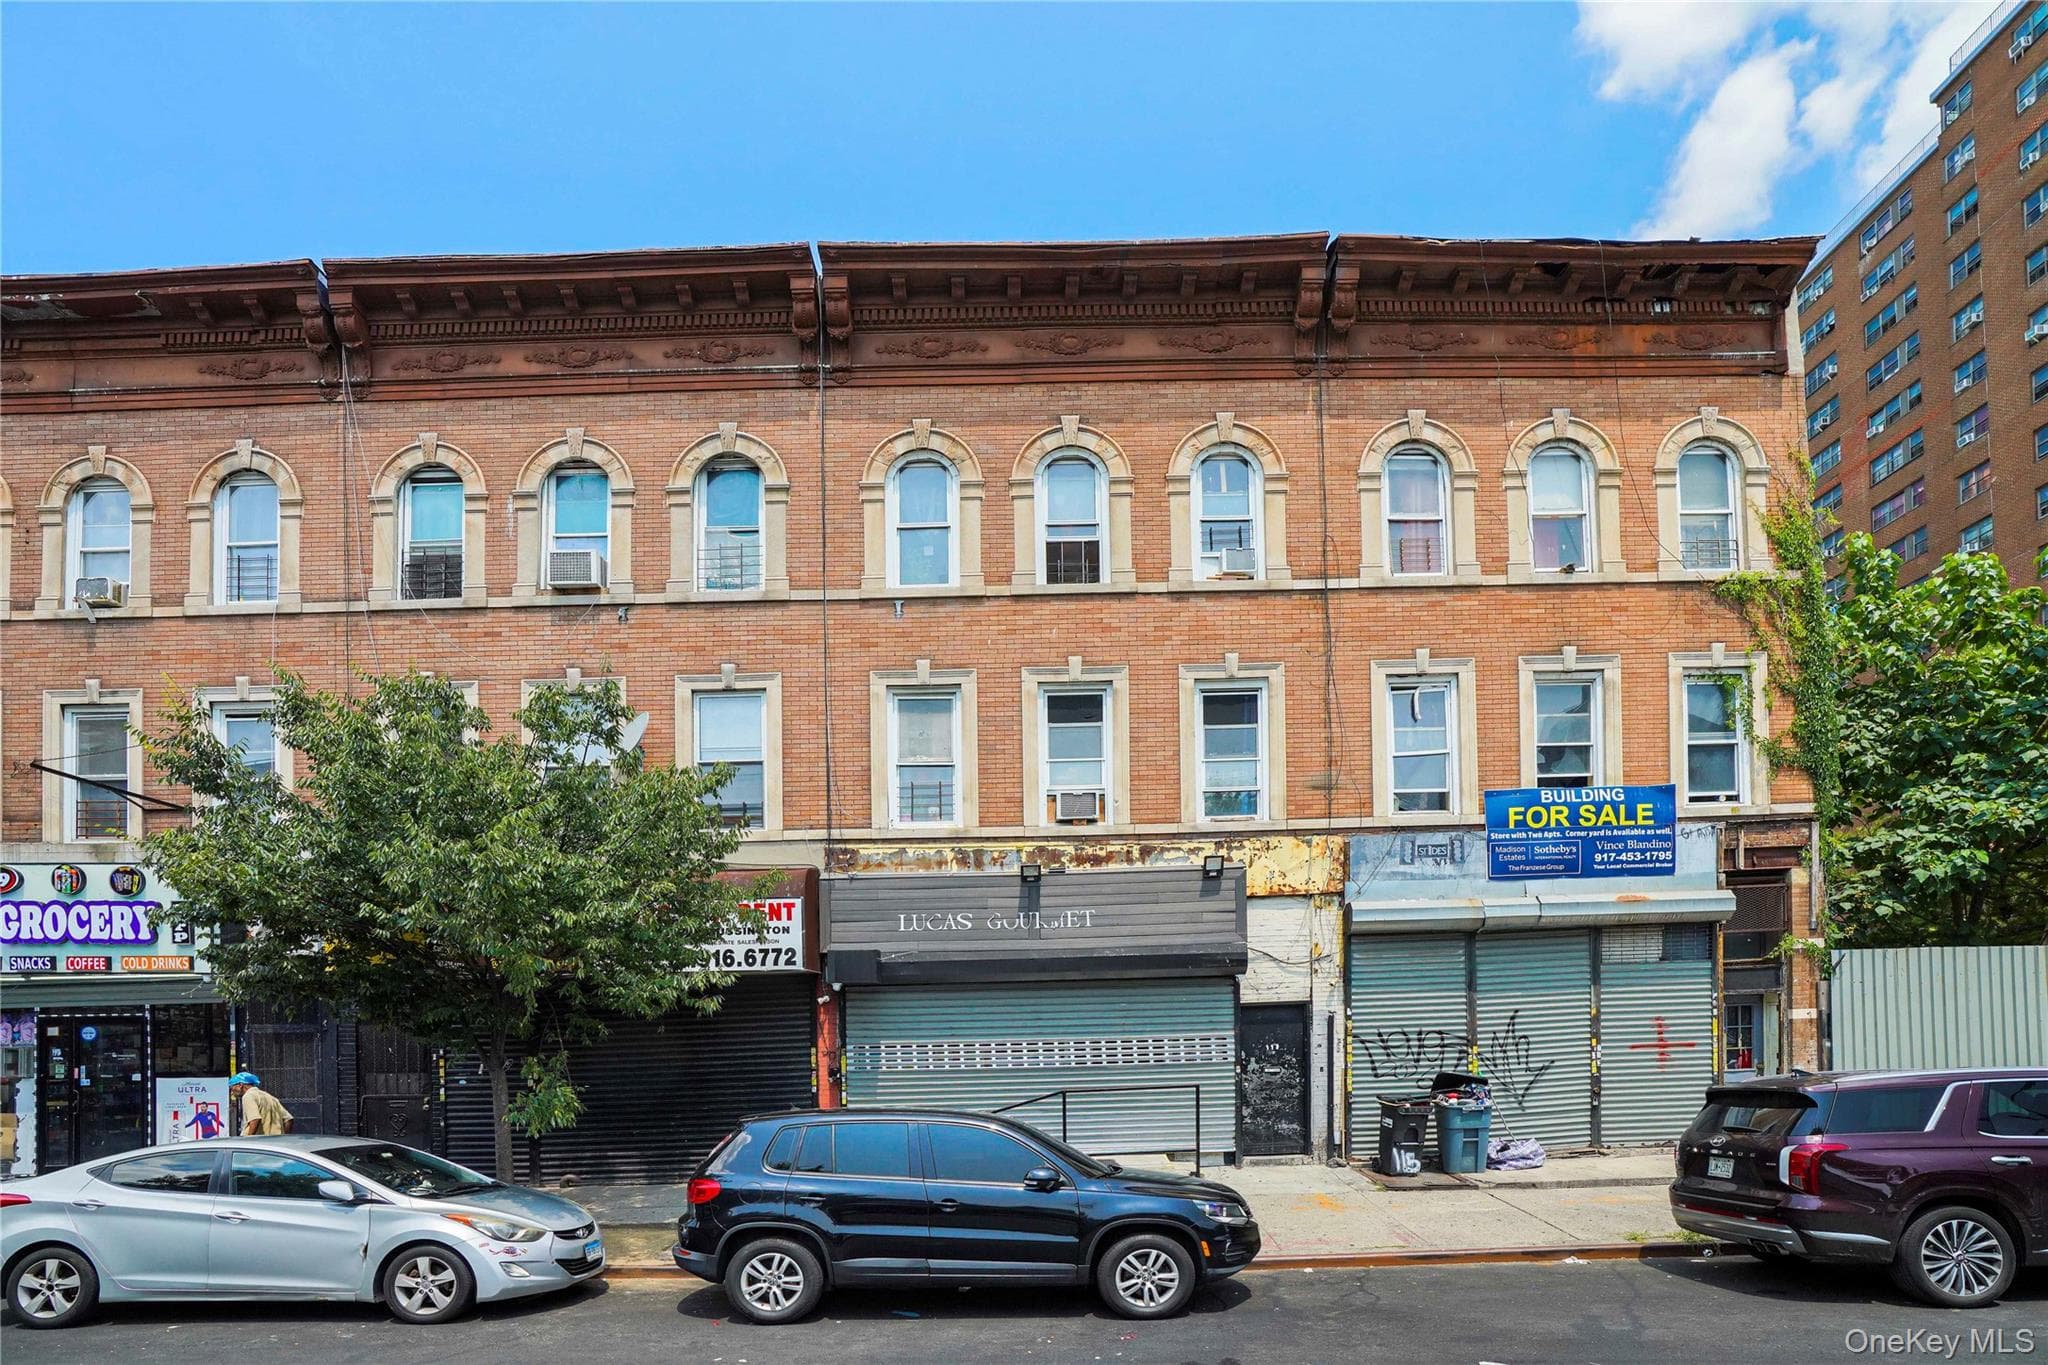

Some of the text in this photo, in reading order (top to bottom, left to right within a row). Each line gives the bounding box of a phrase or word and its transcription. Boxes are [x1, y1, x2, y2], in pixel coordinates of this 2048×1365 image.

[1541, 788, 1624, 803] BUILDING
[1508, 803, 1655, 829] FOR SALE
[1490, 832, 1510, 840] Store
[1511, 831, 1527, 839] with
[1543, 830, 1563, 840] Apts.
[1565, 829, 1588, 838] Corner
[1588, 829, 1605, 838] yard
[1605, 828, 1612, 836] is
[1612, 827, 1646, 836] Available
[1495, 845, 1526, 853] Madison
[1534, 845, 1577, 855] Sotheby's
[1596, 839, 1672, 850] Vince Blandino
[1499, 853, 1526, 862] Estates
[1594, 851, 1673, 862] 917-453-1795
[0, 903, 155, 941] GROCERY
[898, 913, 973, 931] LUCAS
[10, 957, 51, 969] SNACKS
[67, 957, 106, 970] COFFEE
[122, 957, 190, 969] COLD DRINKS
[177, 1086, 208, 1094] ULTRA
